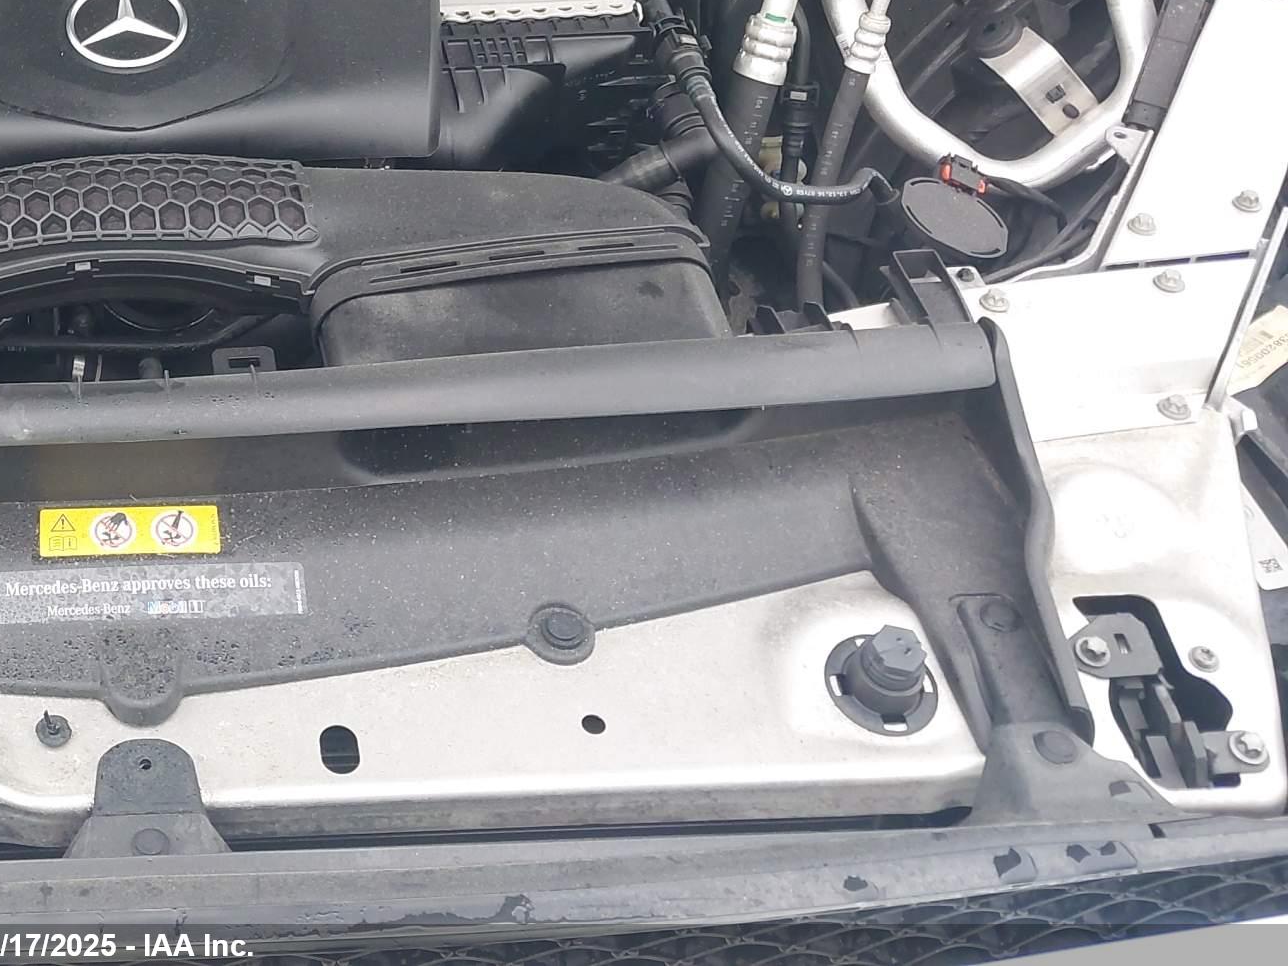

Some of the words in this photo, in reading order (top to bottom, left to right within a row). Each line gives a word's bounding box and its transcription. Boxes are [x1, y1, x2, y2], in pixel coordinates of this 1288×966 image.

[5, 578, 119, 597] Mercedes-Benz
[122, 575, 191, 595] approves
[195, 575, 236, 590] these
[239, 574, 272, 589] oils:
[47, 602, 131, 617] Mercedes-Benz
